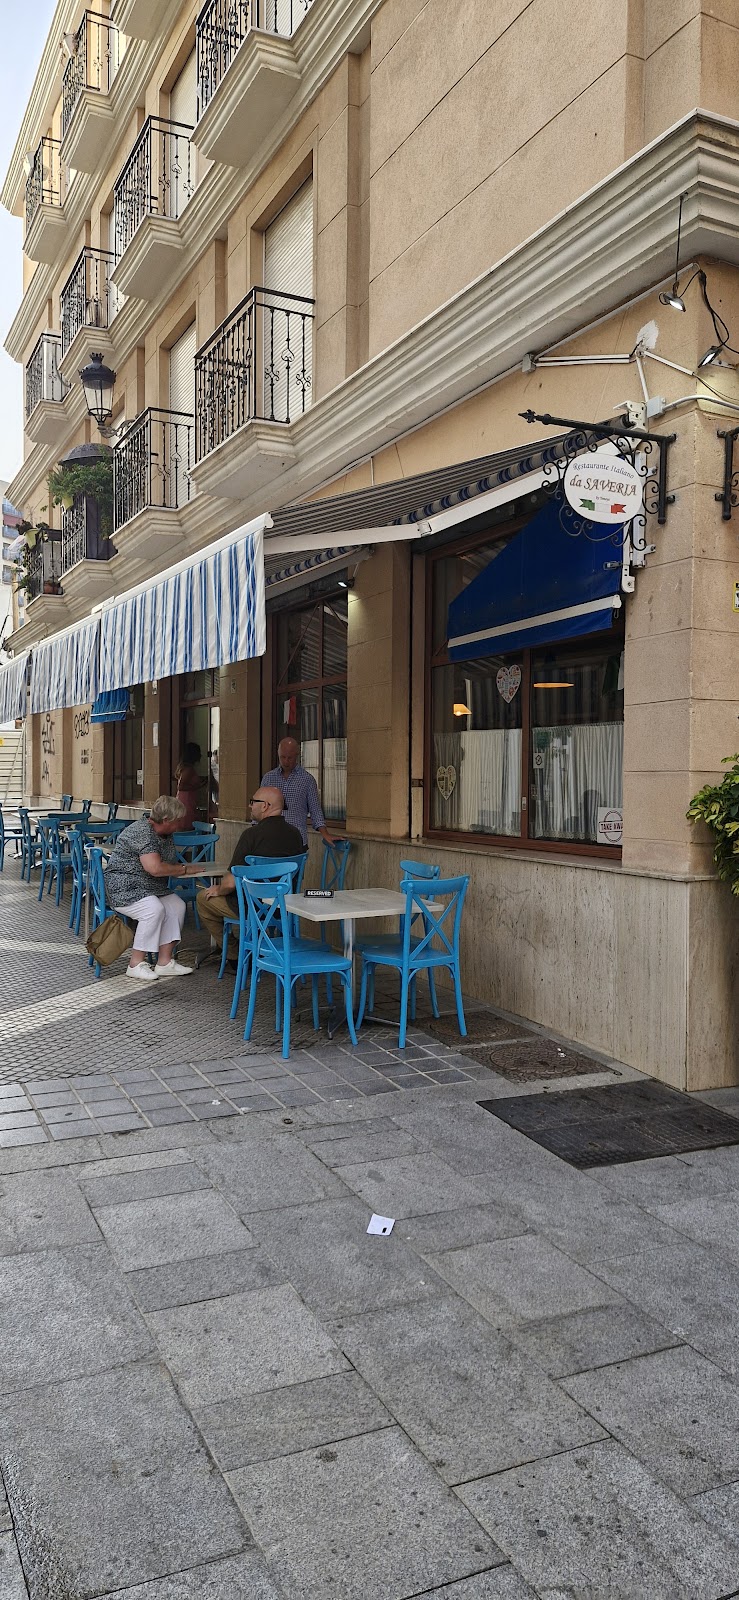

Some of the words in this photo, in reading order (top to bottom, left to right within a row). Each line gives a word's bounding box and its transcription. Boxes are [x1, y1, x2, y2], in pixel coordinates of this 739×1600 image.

[573, 463, 609, 471] Restaurante
[611, 465, 634, 479] Italiano
[570, 474, 582, 488] da
[584, 478, 637, 496] SAVERIA
